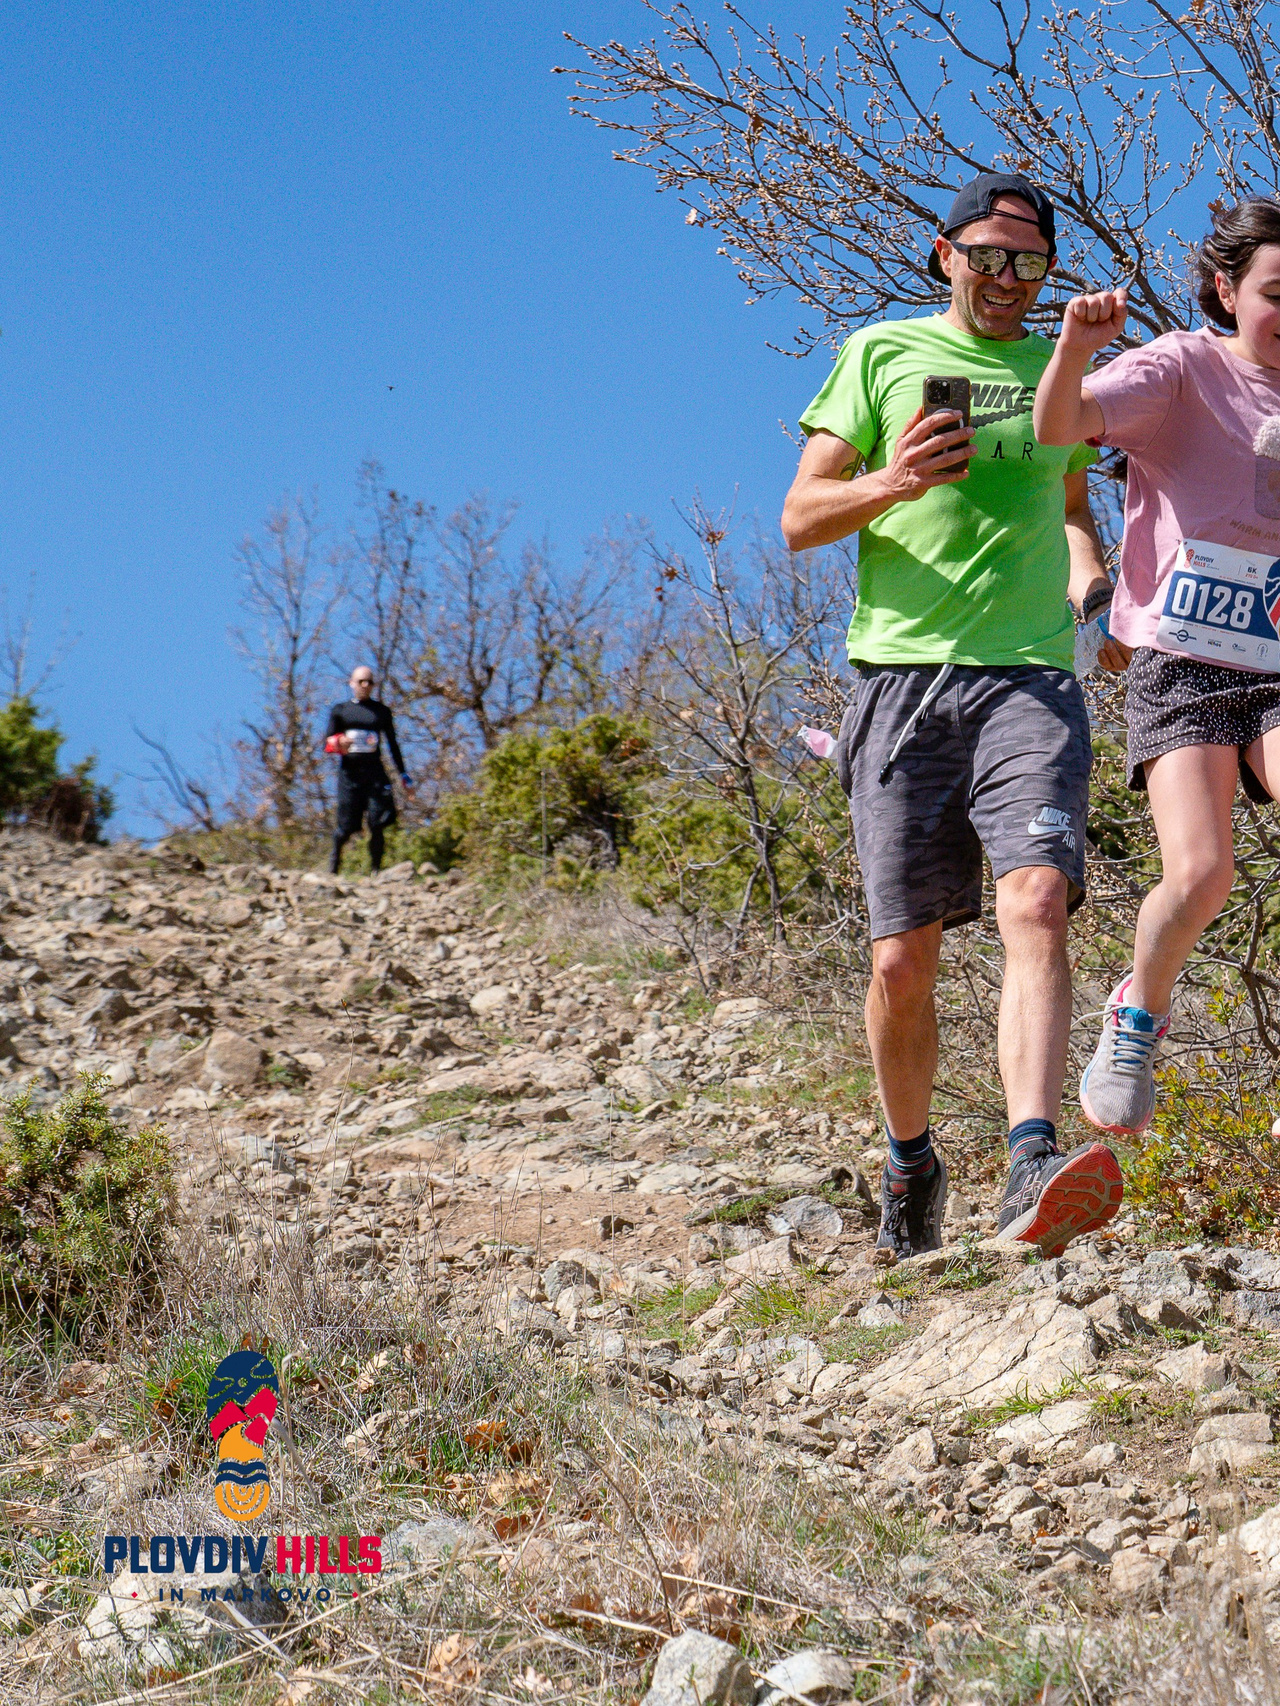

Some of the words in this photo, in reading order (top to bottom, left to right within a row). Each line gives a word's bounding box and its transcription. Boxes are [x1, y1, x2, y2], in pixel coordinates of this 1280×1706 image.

[970, 383, 1036, 411] NIKE
[1230, 519, 1262, 537] WARM
[1172, 577, 1255, 630] 0128
[1037, 806, 1071, 829] NIKE
[1062, 831, 1076, 852] AIR
